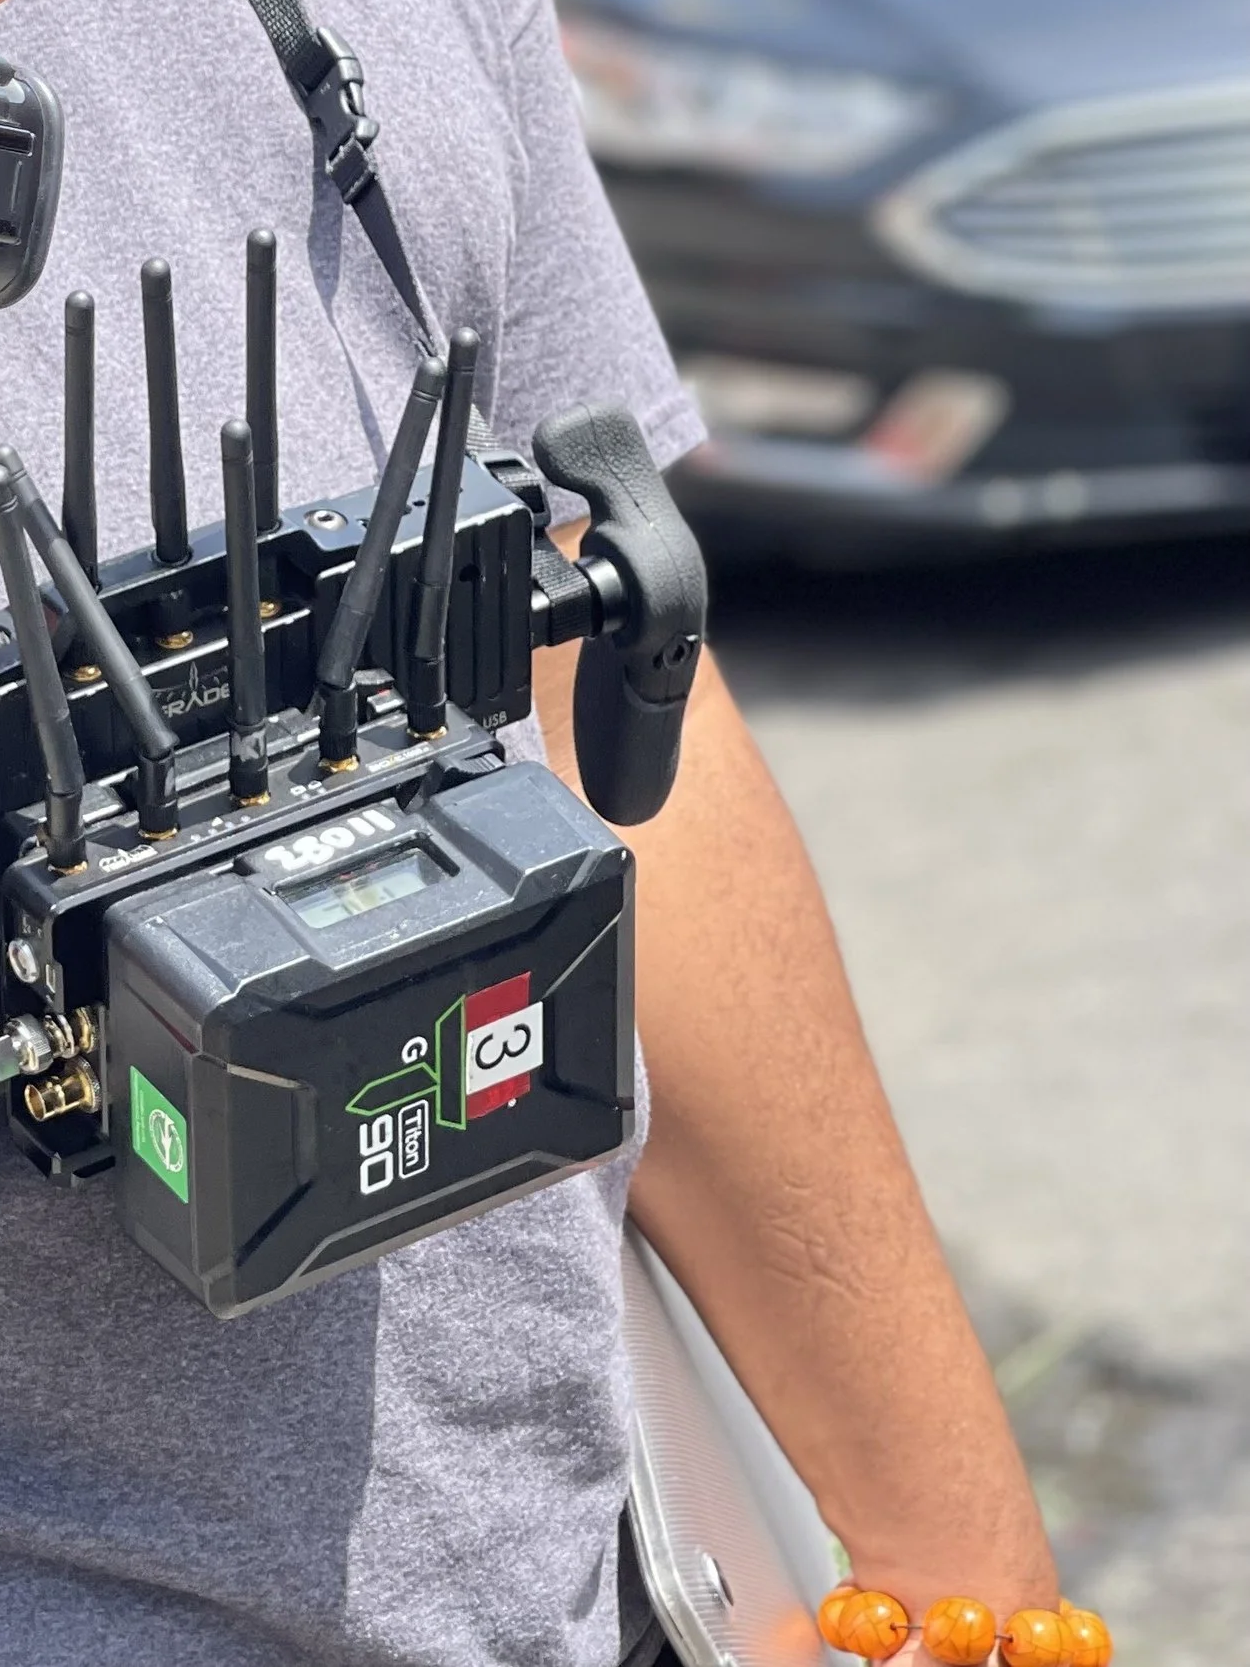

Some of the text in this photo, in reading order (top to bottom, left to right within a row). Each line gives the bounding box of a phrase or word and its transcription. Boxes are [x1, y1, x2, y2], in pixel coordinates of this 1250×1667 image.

[482, 710, 508, 730] USB
[401, 1035, 429, 1064] G
[474, 1023, 532, 1071] 3
[359, 1113, 394, 1196] 90
